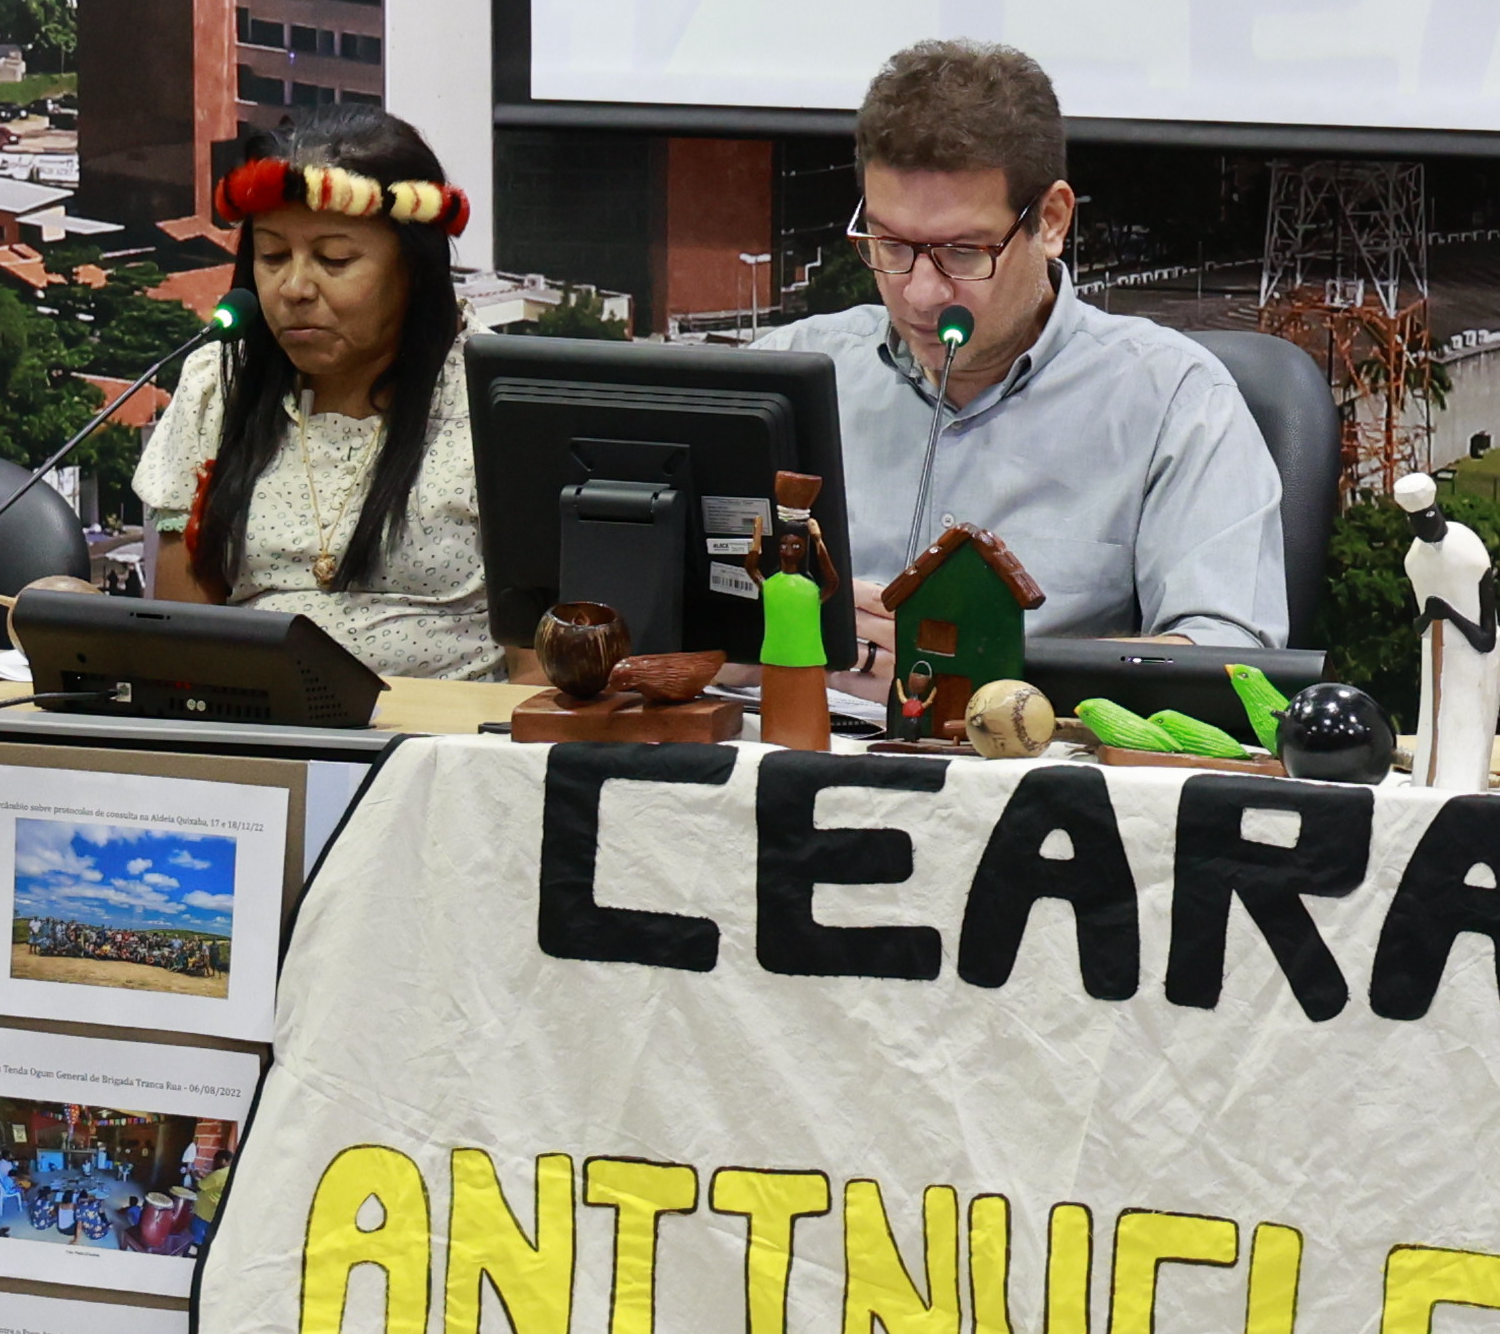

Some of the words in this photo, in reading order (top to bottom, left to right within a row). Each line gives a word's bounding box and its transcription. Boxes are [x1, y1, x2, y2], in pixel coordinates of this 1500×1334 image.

[30, 802, 51, 813] sobre
[53, 805, 94, 818] protocolos
[95, 808, 104, 817] de
[106, 810, 138, 820] consulta
[151, 813, 175, 824] Aldeia
[176, 815, 209, 827] Quixaba,
[210, 818, 219, 827] 17
[228, 820, 264, 832] 18/12/22
[3, 1064, 28, 1076] Tenda
[56, 1069, 88, 1082] General
[90, 1073, 100, 1083] de
[102, 1074, 134, 1088] Brigada
[135, 1078, 164, 1090] Tranca
[166, 1081, 182, 1091] Rua
[189, 1083, 241, 1098] 06/08/2022
